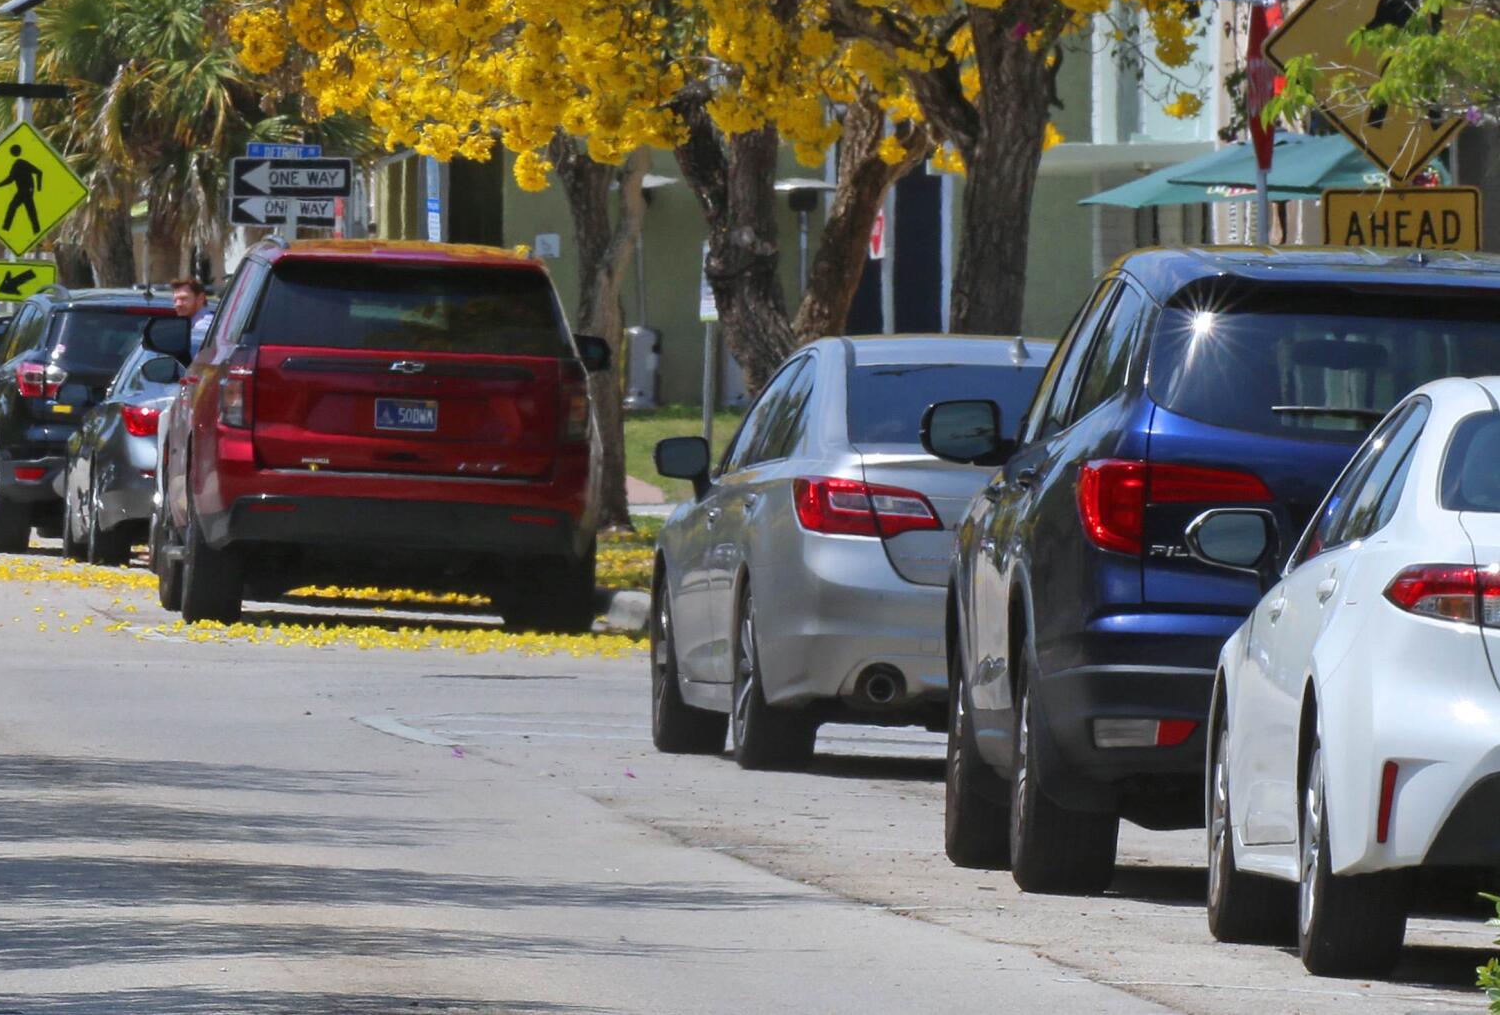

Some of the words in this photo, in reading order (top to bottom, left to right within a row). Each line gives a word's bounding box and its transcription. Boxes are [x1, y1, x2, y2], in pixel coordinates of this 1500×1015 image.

[269, 171, 299, 185] ONE
[306, 171, 339, 185] WAY
[265, 201, 288, 214] ON
[300, 202, 329, 216] WAY
[1345, 210, 1461, 248] AHEAD
[1150, 544, 1188, 557] PIL
